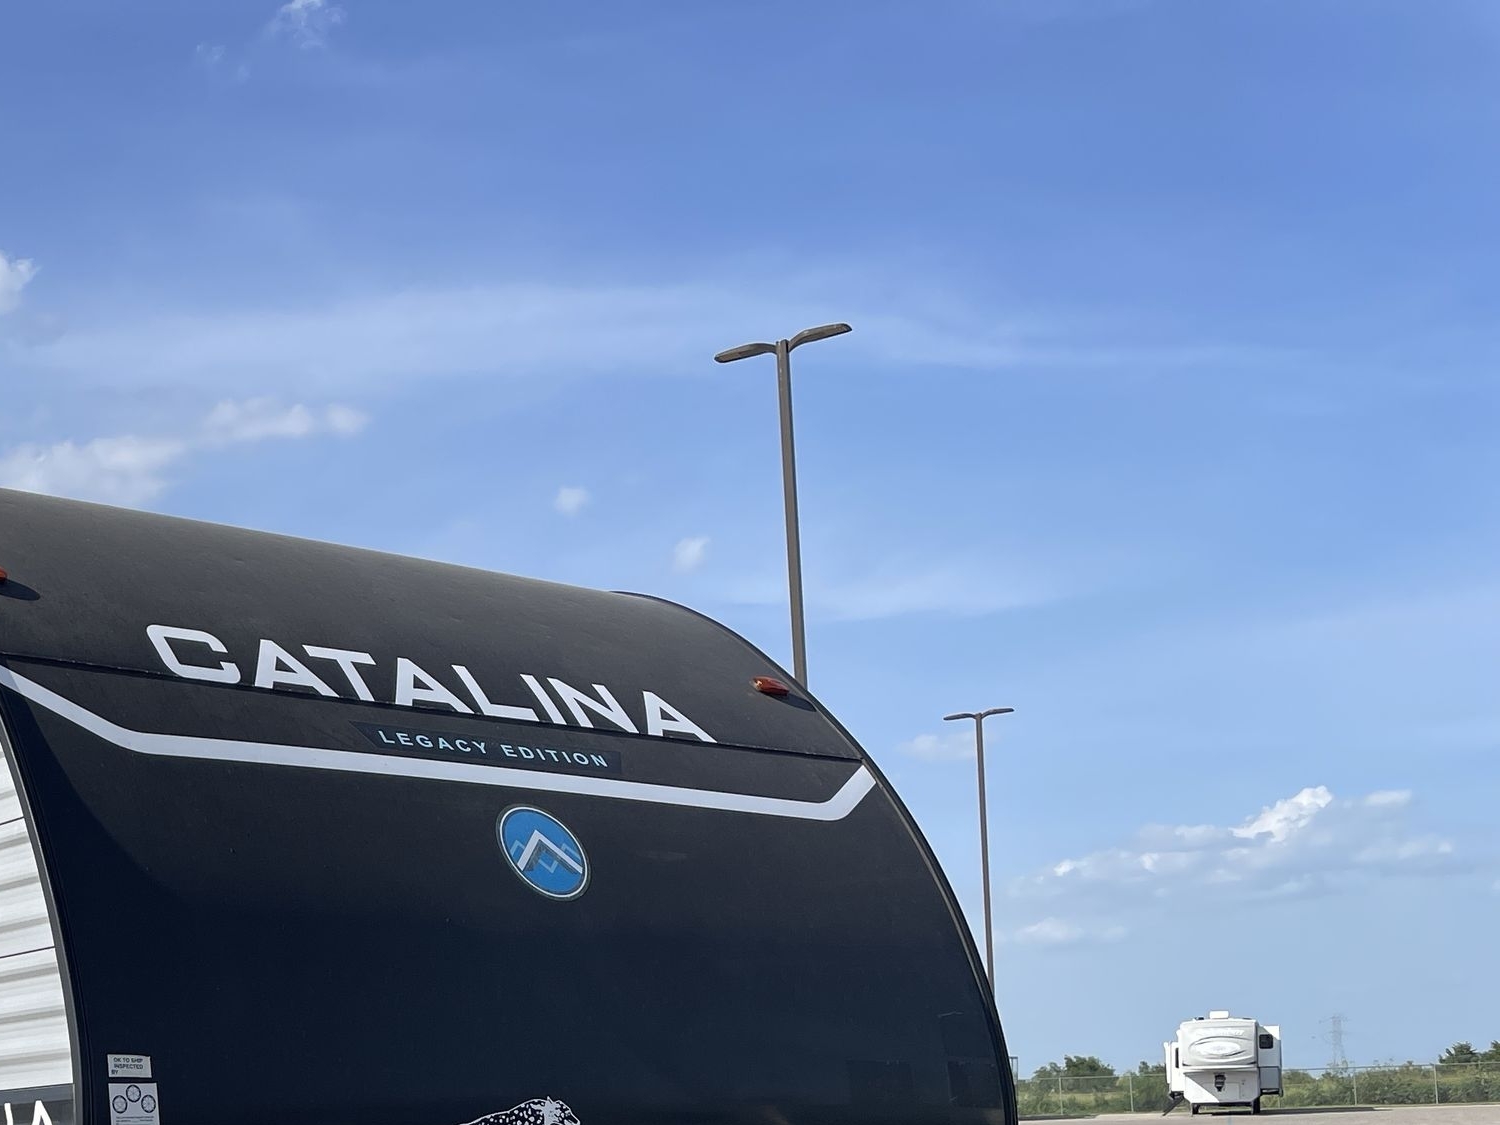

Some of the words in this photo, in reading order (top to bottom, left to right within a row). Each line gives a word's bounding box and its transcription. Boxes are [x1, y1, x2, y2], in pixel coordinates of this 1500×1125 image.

[146, 624, 717, 742] CATALINA
[377, 729, 488, 754] LEGACY
[500, 744, 609, 768] EDITION
